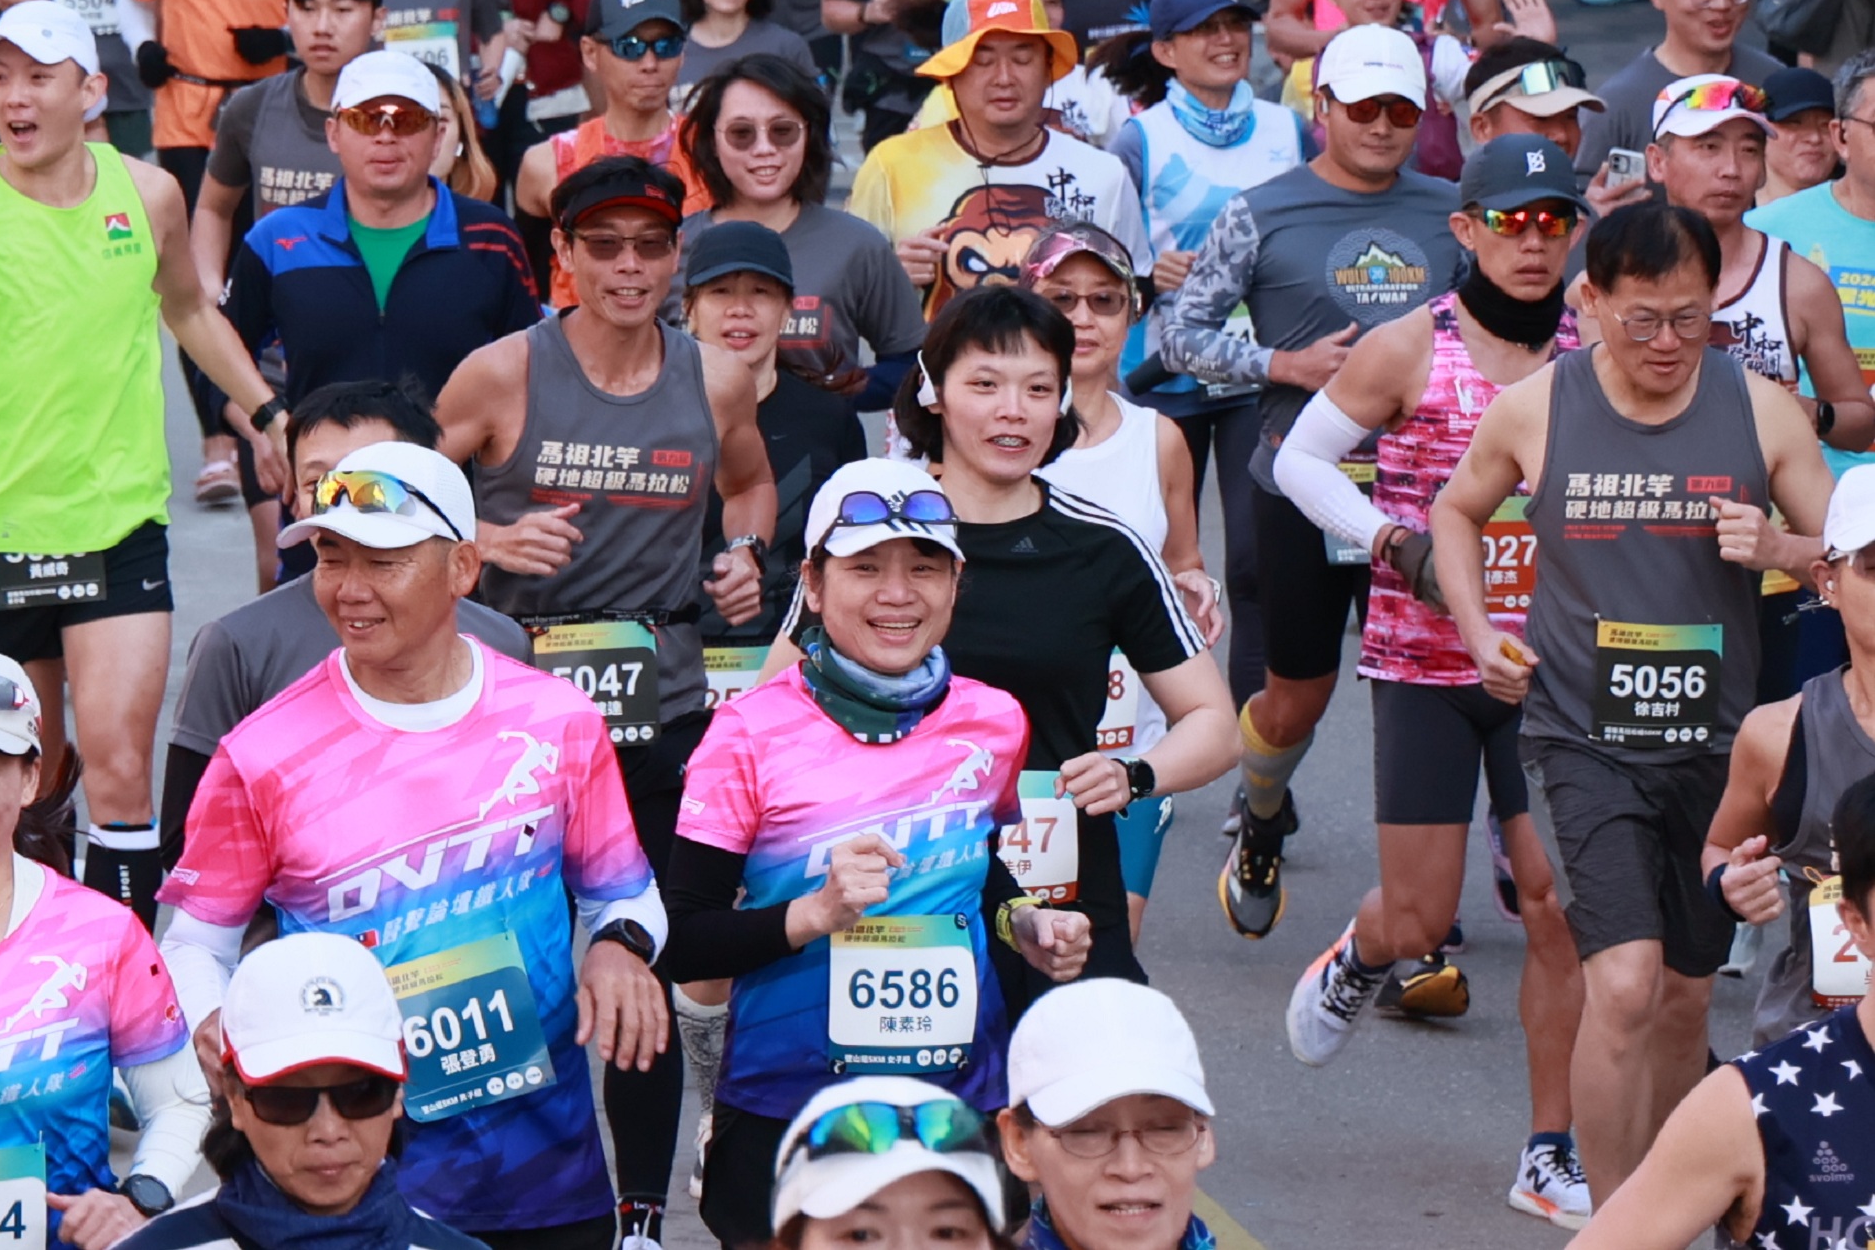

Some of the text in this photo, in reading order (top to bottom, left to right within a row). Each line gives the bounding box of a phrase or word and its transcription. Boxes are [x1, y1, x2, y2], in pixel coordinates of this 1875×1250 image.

[536, 440, 641, 470] 馬祖北竿
[534, 466, 690, 495] 硬地超級馬拉松
[1565, 472, 1675, 499] 馬祖北竿
[1609, 663, 1707, 700] 5056
[1634, 701, 1681, 718] 徐吉村
[848, 967, 960, 1010] 6586
[402, 989, 514, 1058] 6011
[879, 1015, 932, 1033] 陳素玲
[440, 1043, 497, 1076] 張登勇
[1809, 1172, 1855, 1183] svolme
